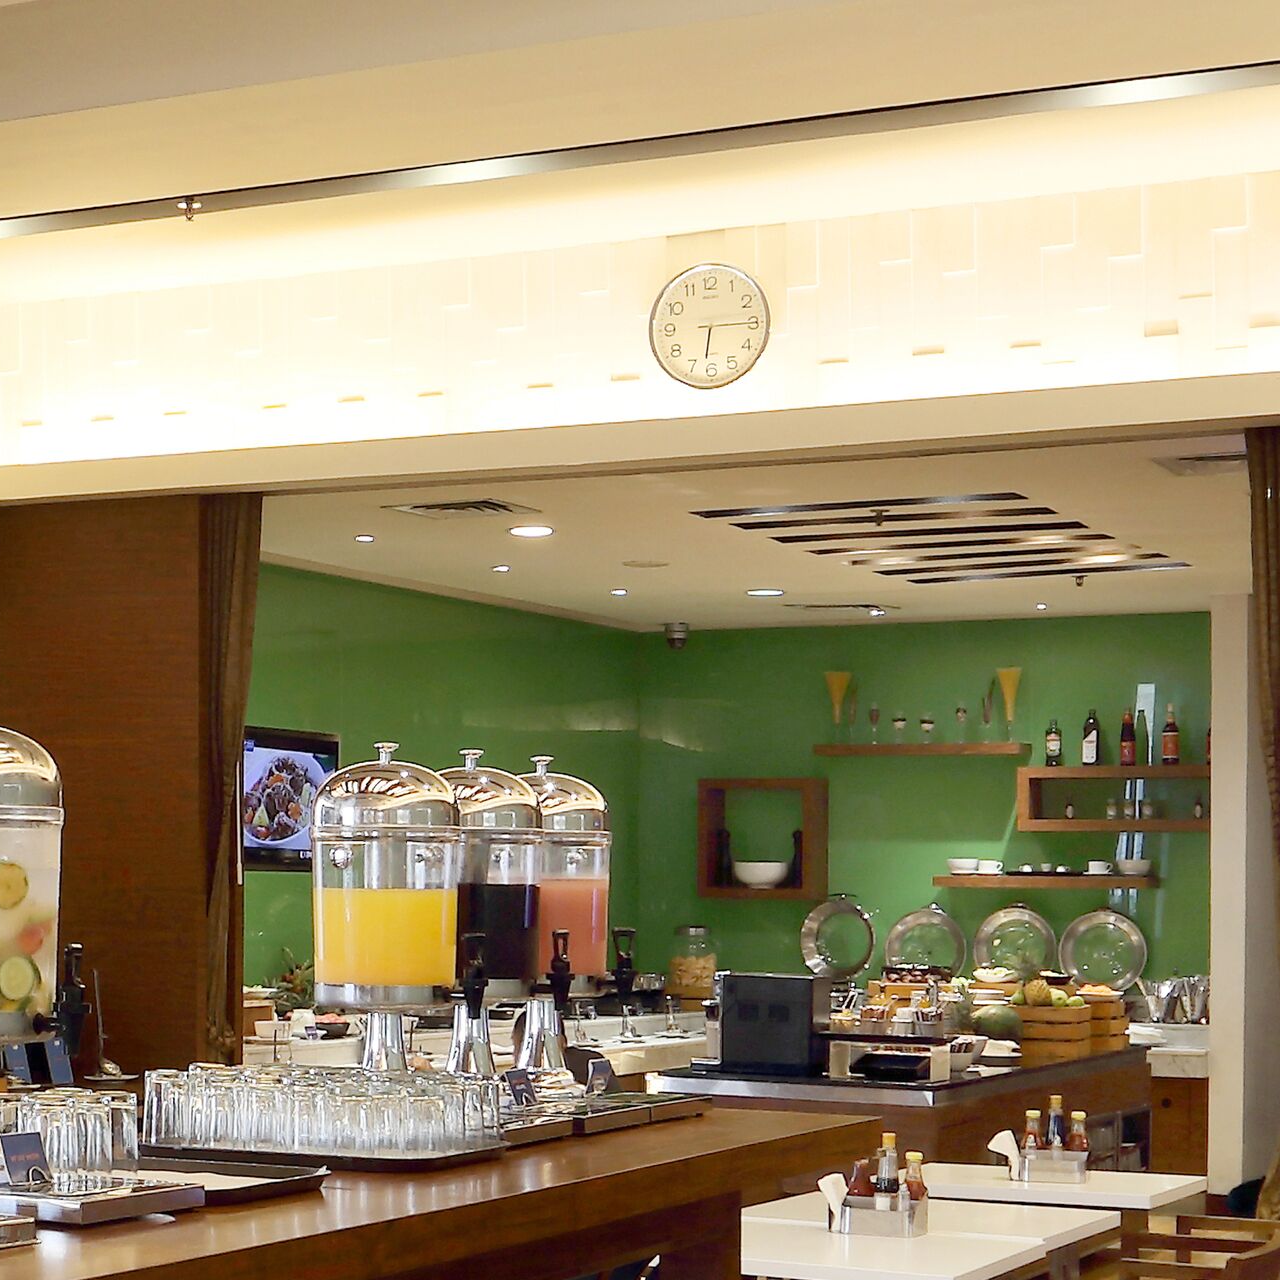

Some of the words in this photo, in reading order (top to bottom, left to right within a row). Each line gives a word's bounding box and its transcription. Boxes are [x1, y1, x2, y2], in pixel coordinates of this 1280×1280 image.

[703, 276, 718, 290] 12
[684, 284, 695, 297] 11
[741, 294, 753, 308] 2
[668, 302, 684, 316] 10
[664, 323, 676, 337] 9
[747, 316, 759, 330] 3
[671, 344, 682, 358] 8
[741, 338, 752, 351] 4
[688, 359, 698, 373] 7
[706, 363, 717, 377] 6
[727, 356, 738, 370] 5
